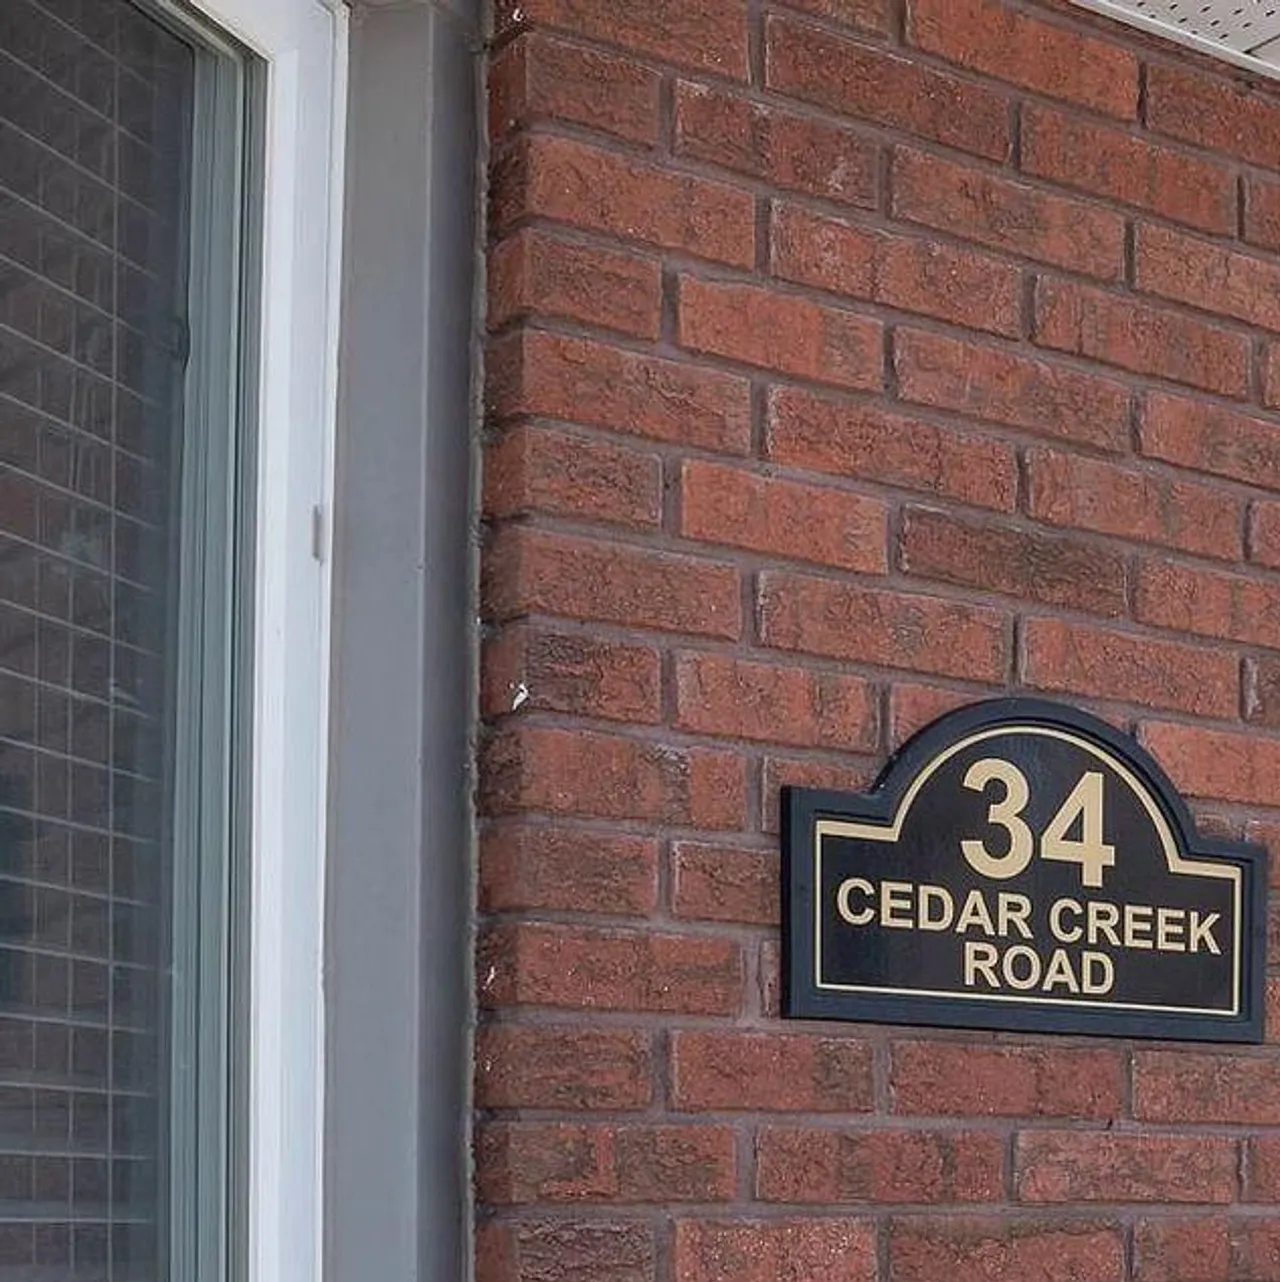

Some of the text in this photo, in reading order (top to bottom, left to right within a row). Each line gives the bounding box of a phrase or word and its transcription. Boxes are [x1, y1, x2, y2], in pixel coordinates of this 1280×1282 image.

[961, 758, 1115, 887] 34
[837, 877, 1222, 954] CEDAR CREEK
[963, 941, 1114, 995] ROAD
